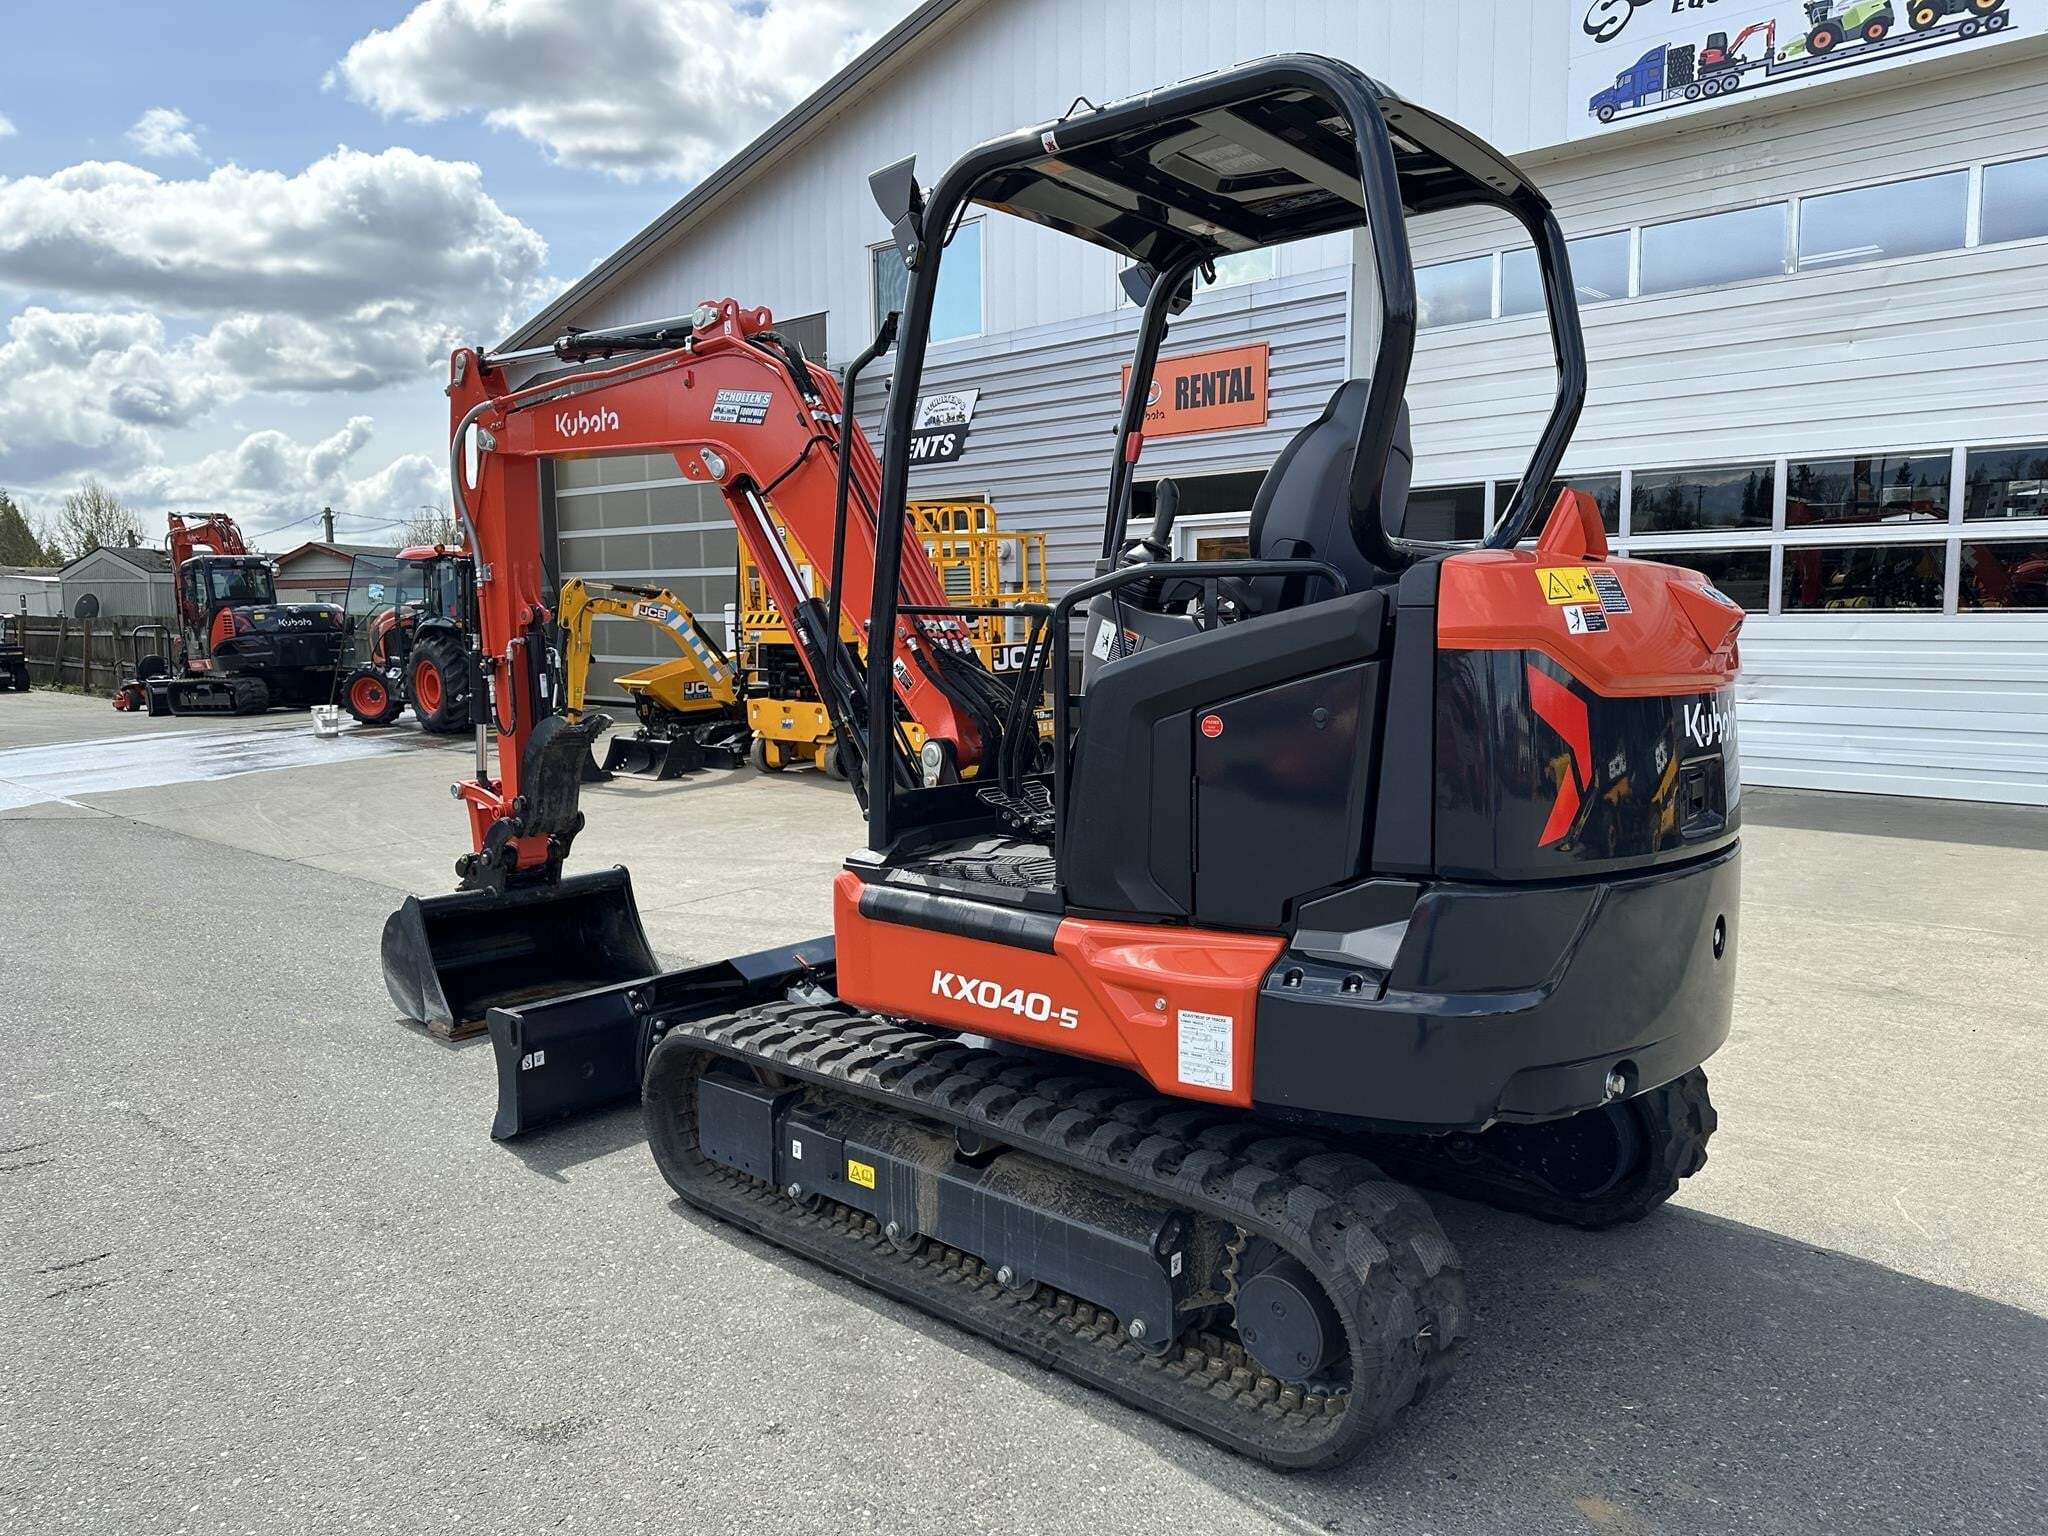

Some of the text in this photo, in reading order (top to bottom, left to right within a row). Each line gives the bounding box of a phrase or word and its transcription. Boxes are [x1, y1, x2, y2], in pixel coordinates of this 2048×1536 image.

[1175, 366, 1255, 411] RENTAL
[555, 406, 619, 437] Kubota
[1145, 409, 1165, 421] bota
[909, 433, 956, 459] ENTS
[278, 618, 312, 626] Kubota
[640, 605, 667, 619] JCB
[684, 681, 711, 695] JC
[931, 969, 1079, 1029] KX040-5
